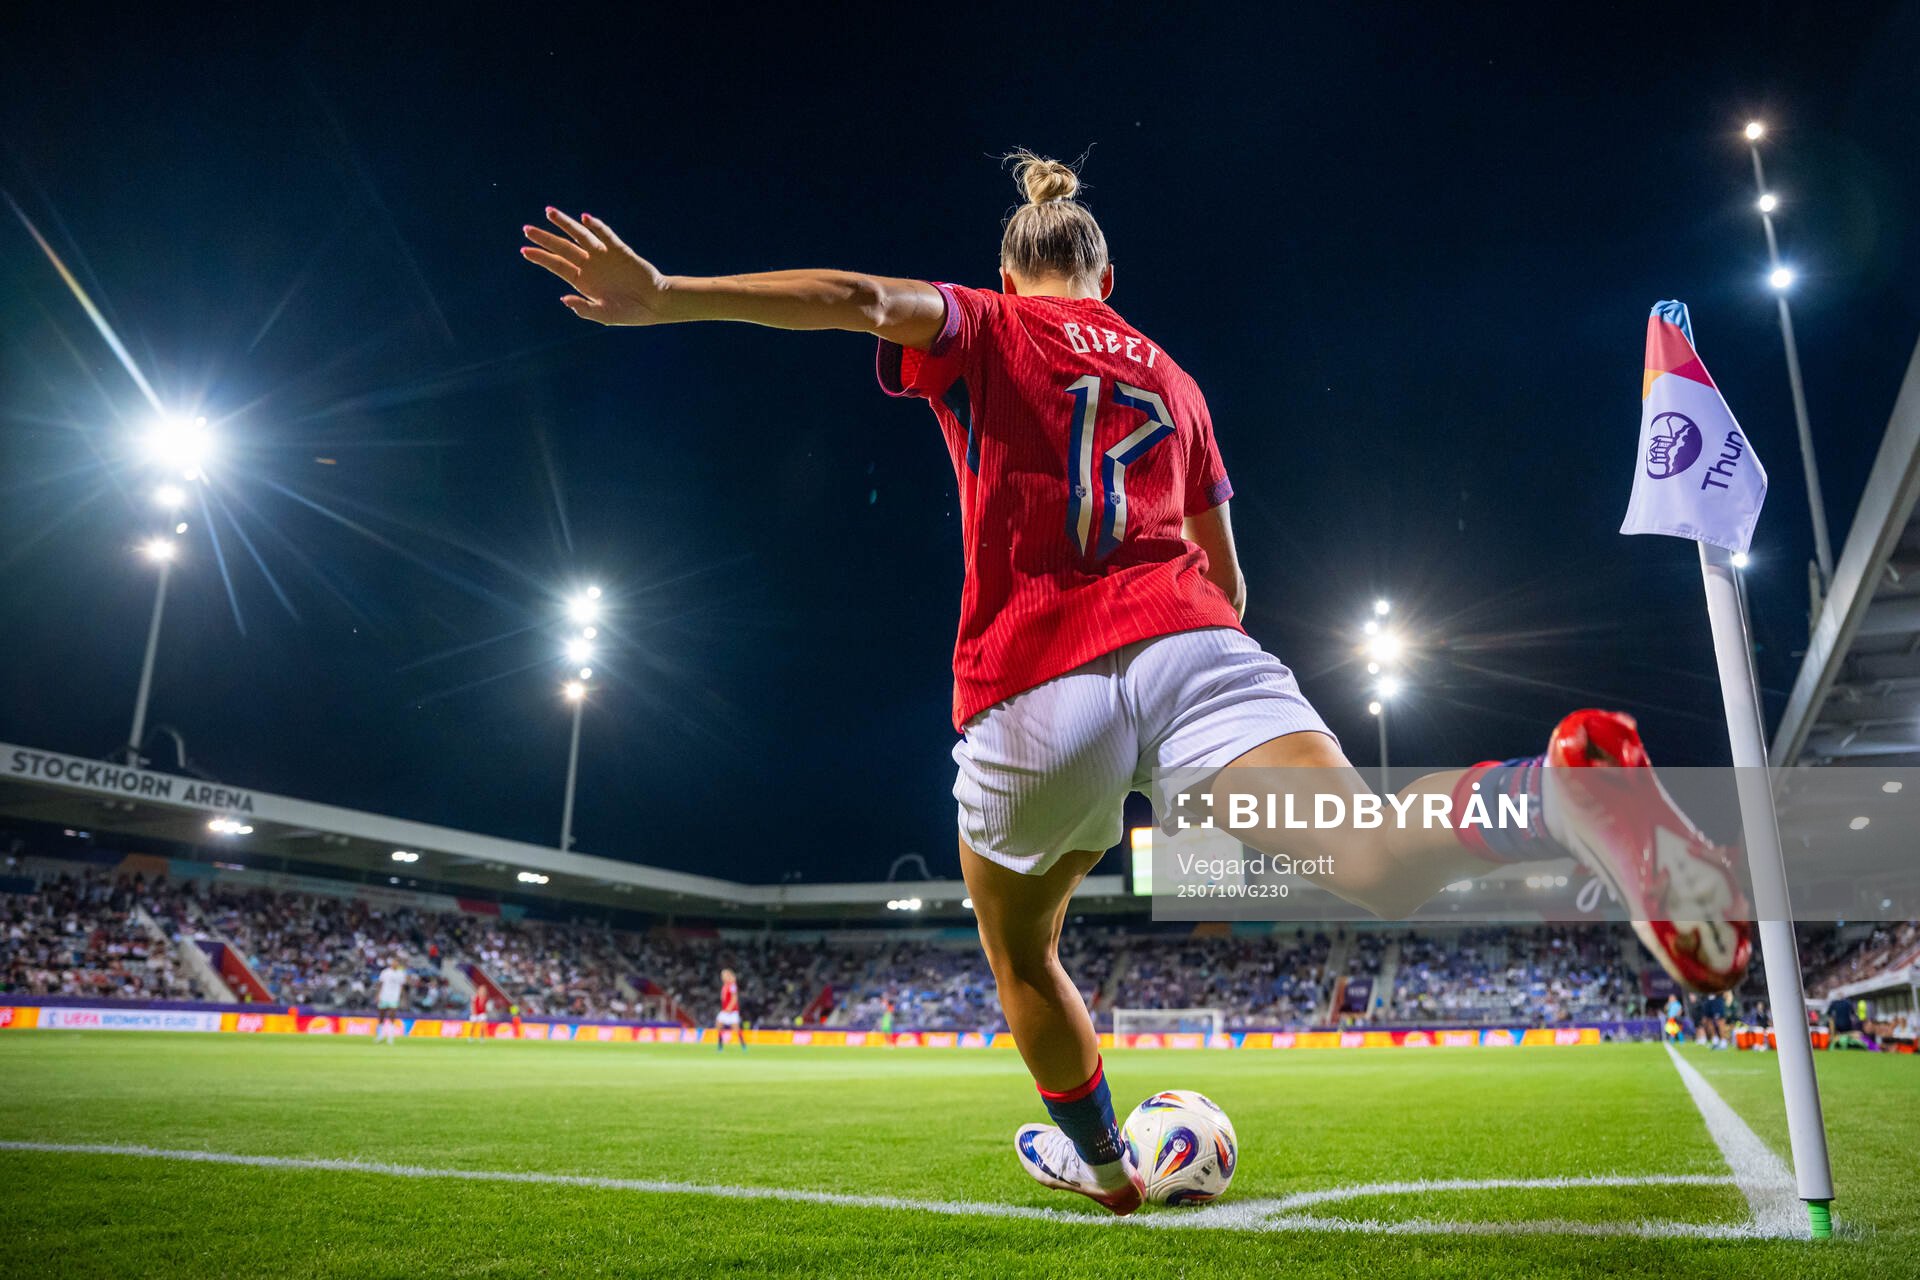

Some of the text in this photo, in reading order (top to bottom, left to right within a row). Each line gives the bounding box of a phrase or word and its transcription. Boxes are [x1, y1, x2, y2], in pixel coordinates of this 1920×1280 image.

[1064, 374, 1175, 560] 17
[1701, 430, 1744, 490] Thun
[11, 751, 254, 812] STOCKHORN ARENA
[63, 1013, 99, 1025] UEFA
